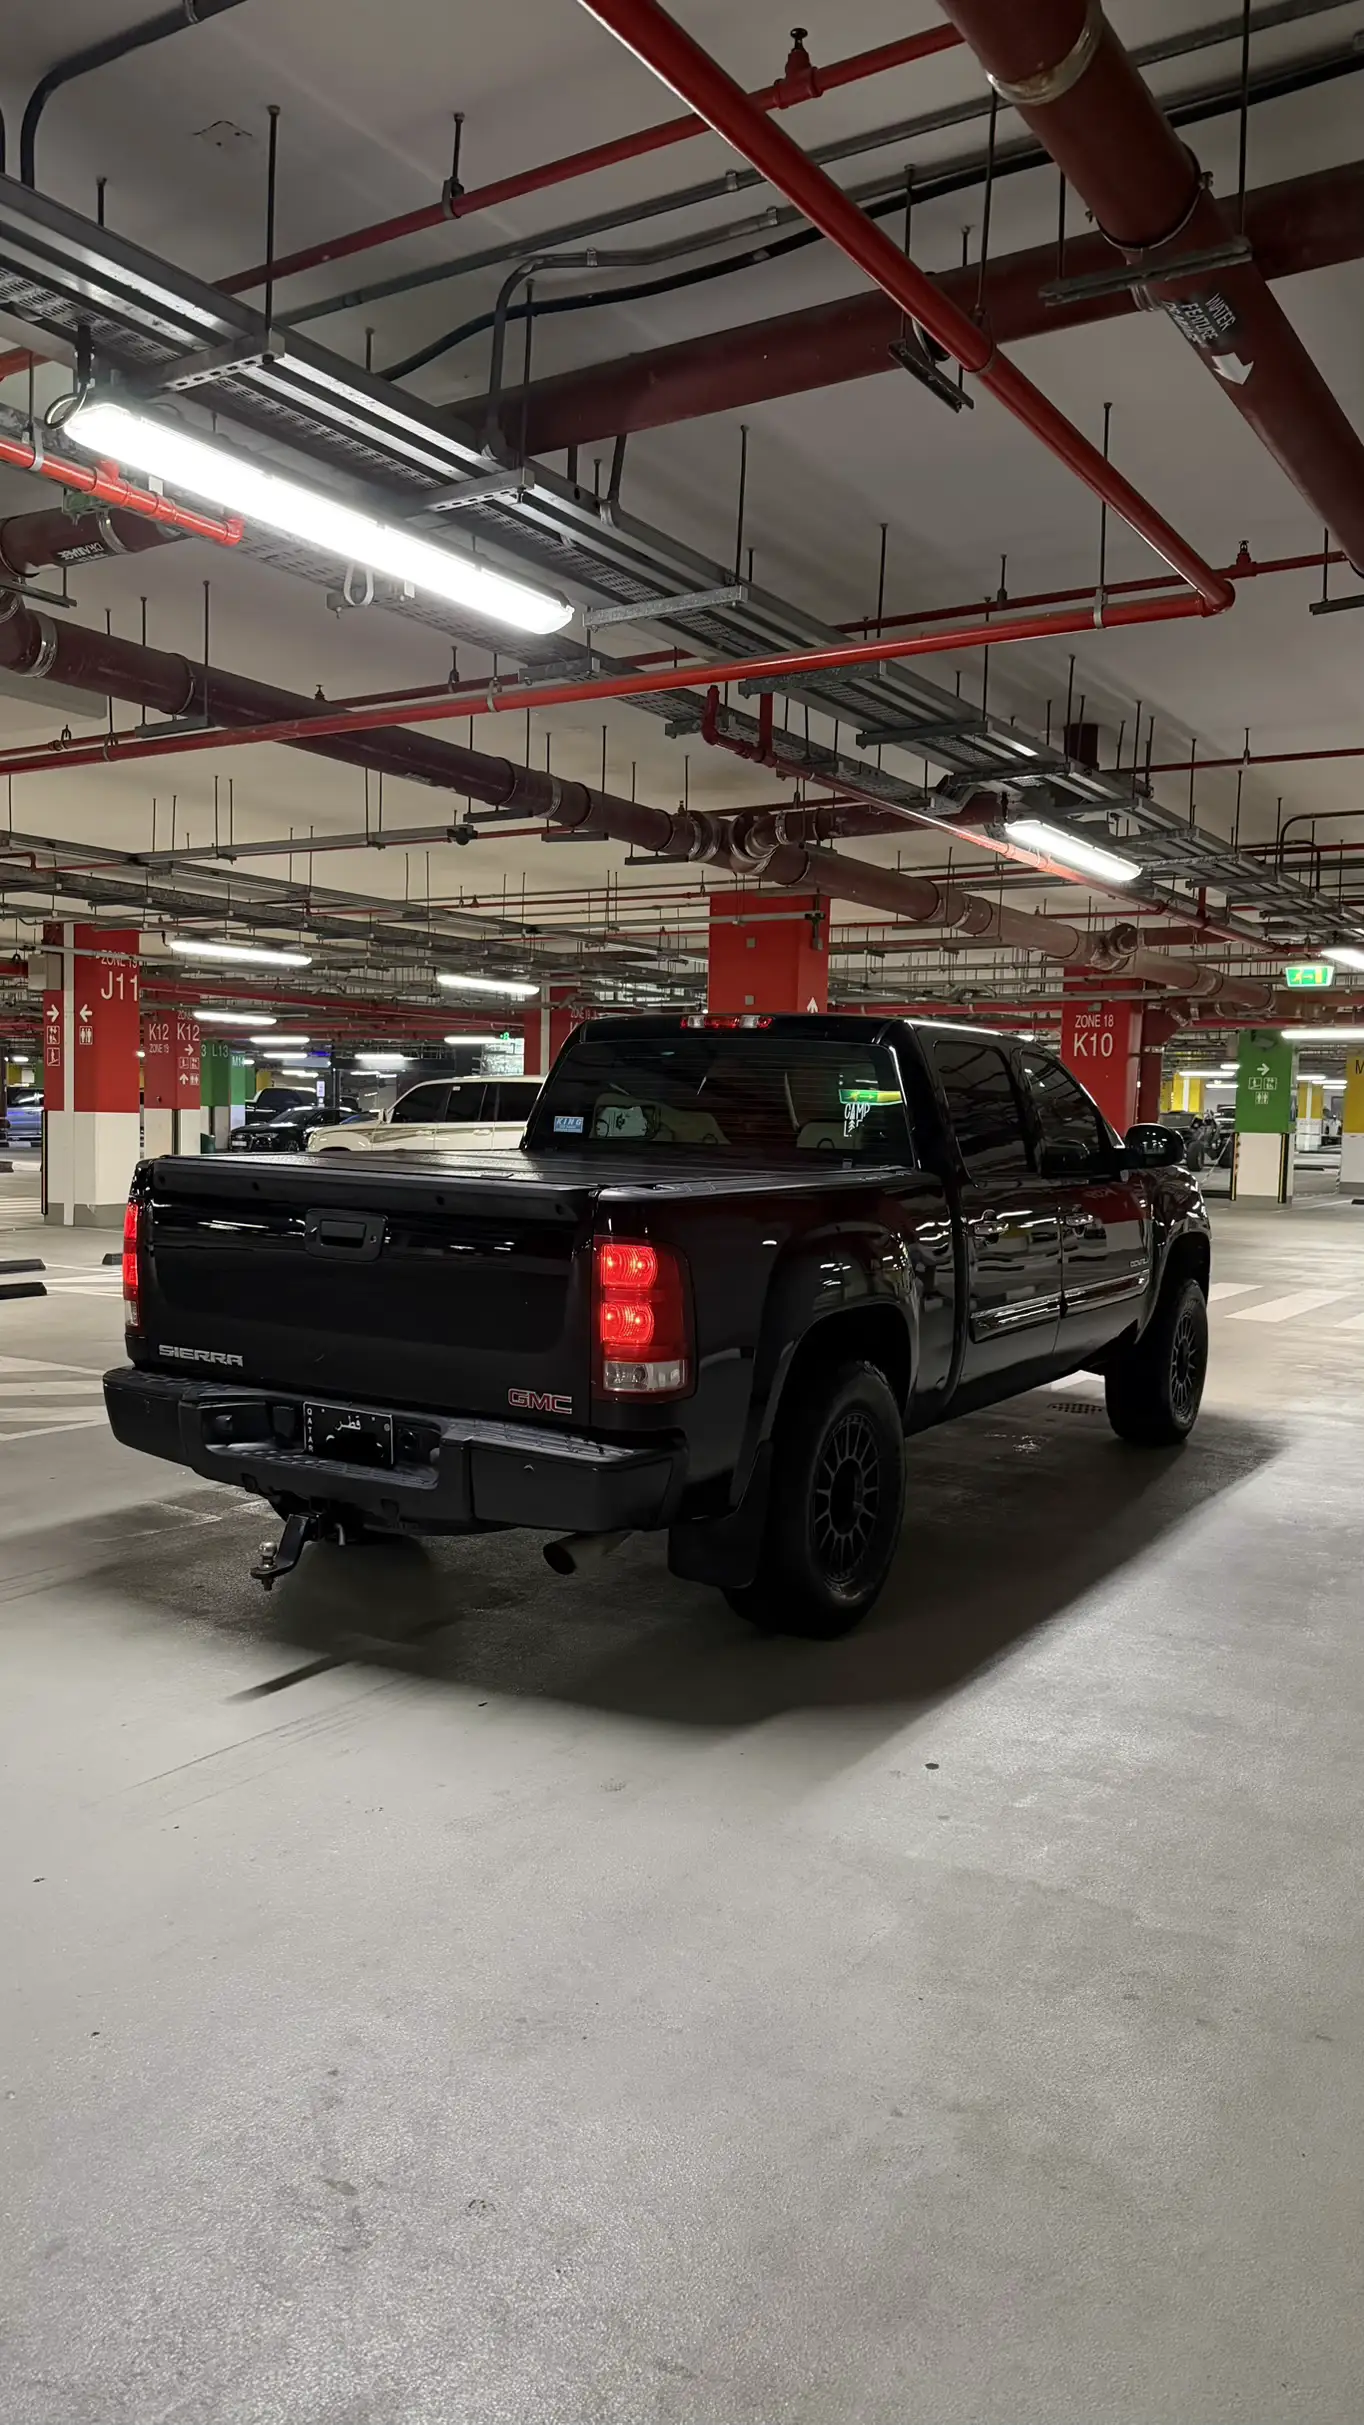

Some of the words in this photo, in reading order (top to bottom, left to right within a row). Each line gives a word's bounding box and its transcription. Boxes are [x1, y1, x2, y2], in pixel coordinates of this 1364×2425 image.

[1181, 302, 1219, 341] FEATURE
[1205, 292, 1236, 331] WATER
[101, 971, 138, 1002] J11
[1075, 1014, 1101, 1028] ZONE
[1104, 1014, 1114, 1028] 18
[149, 1023, 169, 1041] K12
[177, 1022, 200, 1042] K12
[149, 1043, 163, 1053] ZONE
[212, 1045, 229, 1057] L13
[1073, 1032, 1113, 1057] K10
[556, 1117, 582, 1125] KING
[844, 1102, 870, 1120] CAMP
[158, 1344, 243, 1368] SIERRA
[508, 1388, 573, 1415] GMC
[306, 1407, 314, 1453] QATAR
[335, 1415, 362, 1431] قطر
